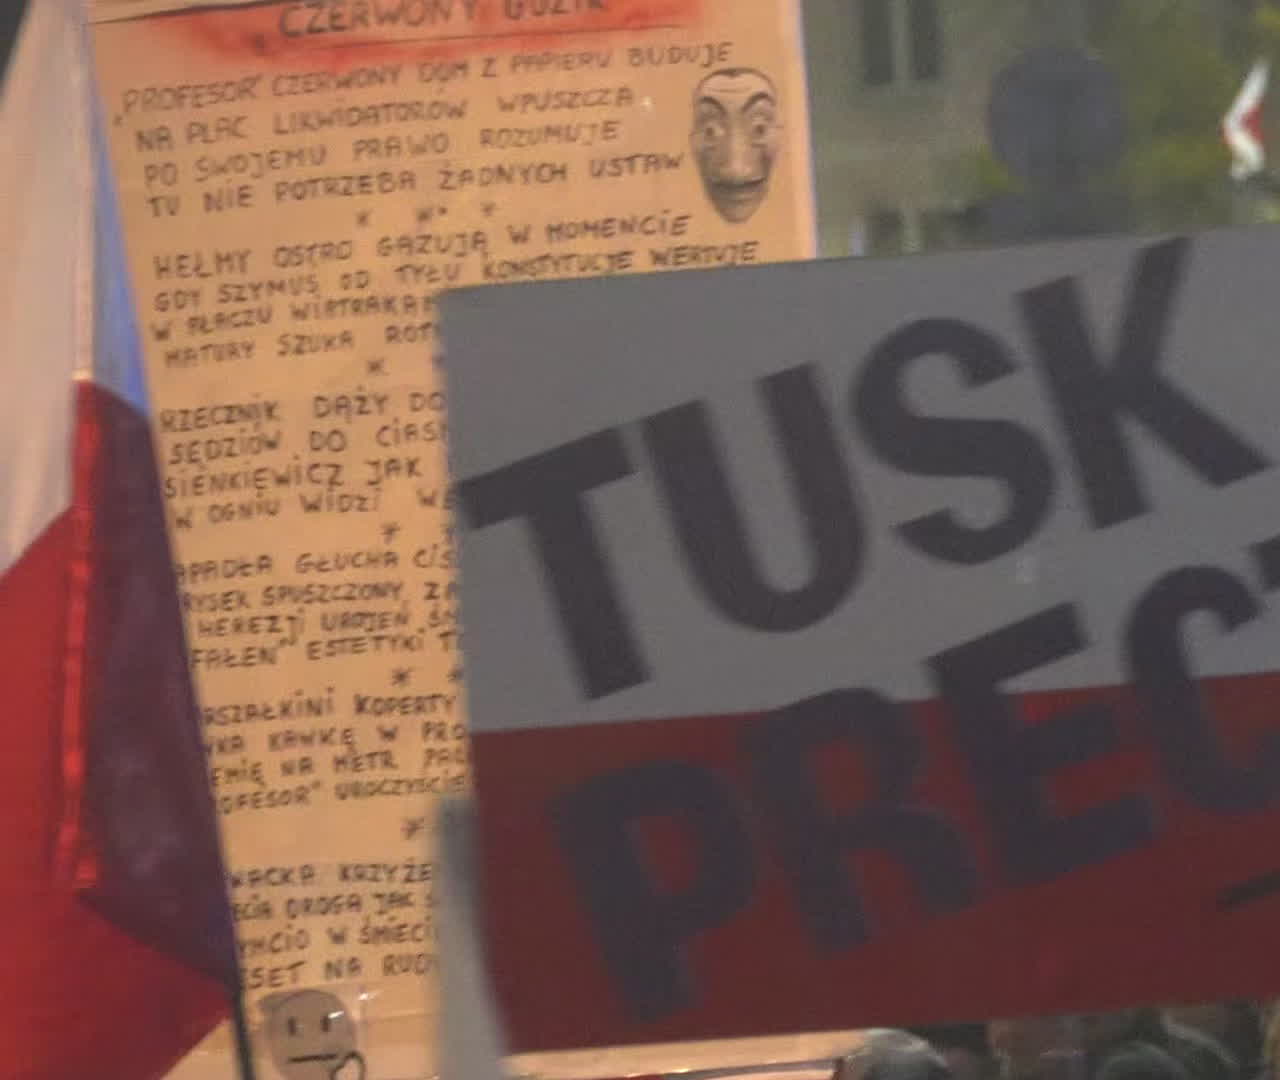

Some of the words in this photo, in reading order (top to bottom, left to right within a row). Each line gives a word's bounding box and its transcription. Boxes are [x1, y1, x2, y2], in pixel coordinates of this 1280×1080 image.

[272, 64, 403, 97] CZERWONY
[417, 59, 470, 83] DOM
[481, 57, 496, 78] Z
[511, 48, 611, 74] PAPIERU
[628, 42, 733, 68] BUDUJE
[136, 126, 175, 152] NA
[496, 87, 635, 114] WPUSZCZA
[144, 162, 178, 189] PO
[194, 145, 327, 183] SWOJEMU
[352, 133, 450, 161] PRAWO
[479, 120, 622, 149] ROZUMUJE
[148, 196, 182, 218] TU
[202, 184, 254, 215] NIE
[275, 171, 417, 203] POTRZEBA
[589, 152, 686, 179] USTAW
[272, 240, 352, 268] OSTRO
[509, 223, 532, 244] W
[153, 288, 202, 313] GDY
[151, 320, 173, 341] W
[164, 341, 255, 368] MATURY
[276, 330, 354, 358] SZUKA
[160, 400, 280, 433] RZECZNIK
[309, 429, 347, 453] DO
[365, 457, 422, 487] JAK
[457, 237, 1278, 702] TUSK
[354, 693, 454, 716] KOPERTY
[281, 757, 314, 775] NA
[334, 750, 397, 773] METR
[325, 958, 362, 980] NA
